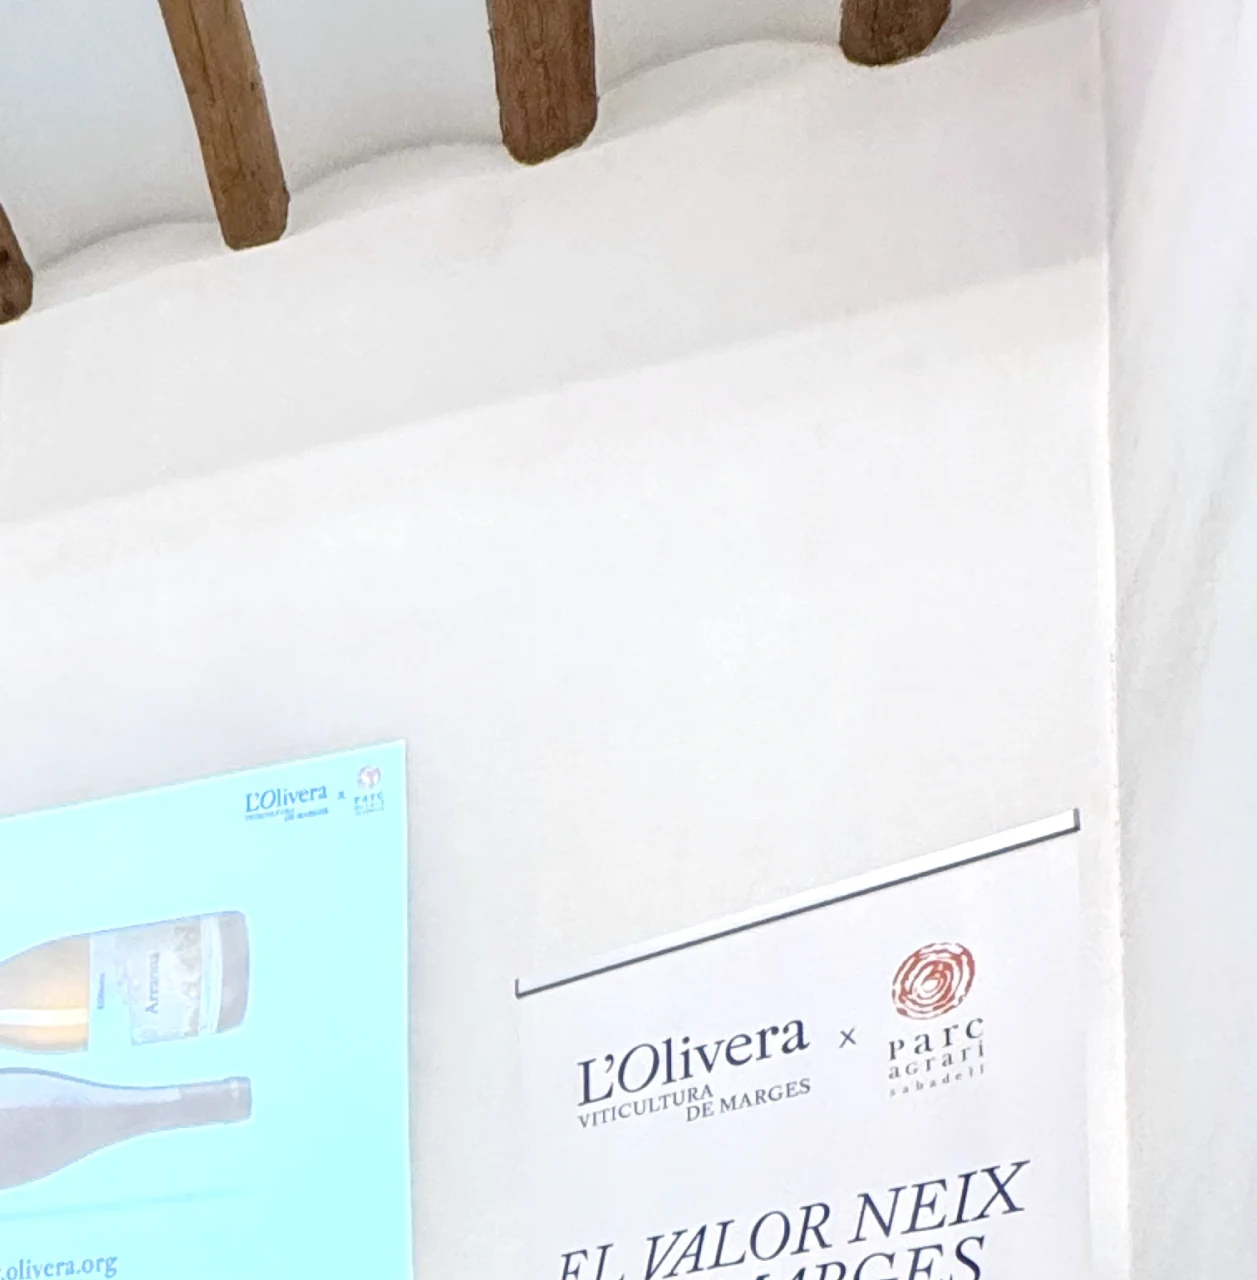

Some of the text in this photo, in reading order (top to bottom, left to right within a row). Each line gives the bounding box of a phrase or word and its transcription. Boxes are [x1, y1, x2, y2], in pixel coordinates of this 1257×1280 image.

[245, 785, 328, 813] L'Olivera
[576, 1019, 811, 1107] L'Olivera
[577, 1083, 714, 1129] VITICULTURA
[685, 1078, 812, 1123] DE MARGES
[848, 1158, 1032, 1245] NEIX
